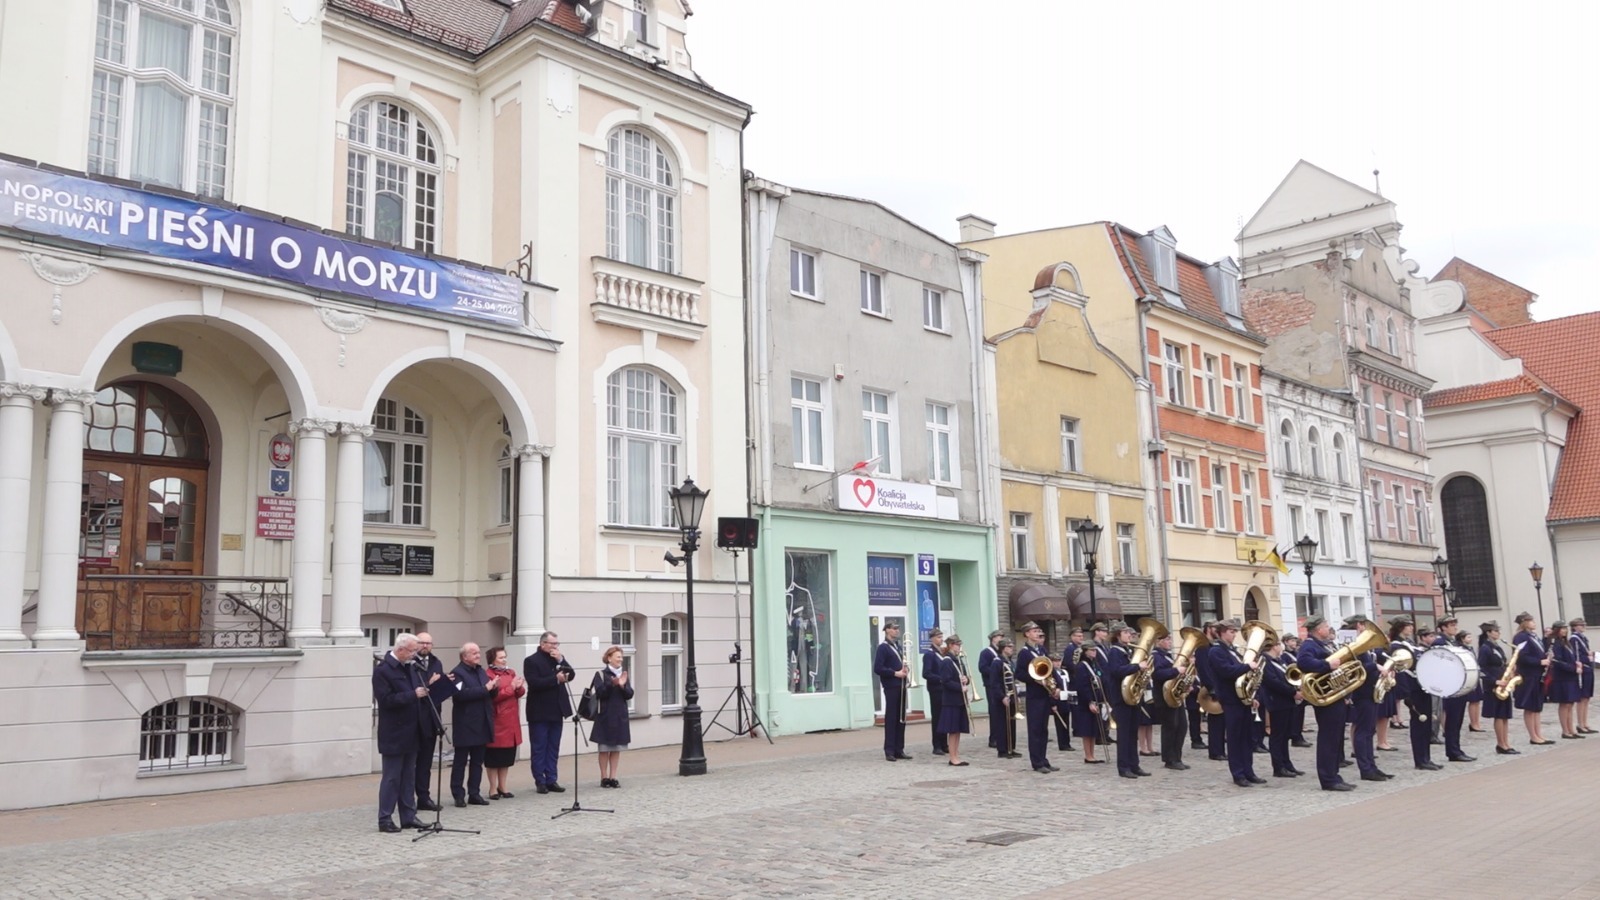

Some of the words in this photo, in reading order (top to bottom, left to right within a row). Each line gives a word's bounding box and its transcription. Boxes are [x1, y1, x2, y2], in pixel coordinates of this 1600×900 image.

[0, 179, 114, 217] NOPOLSKI
[14, 201, 110, 235] FESTIWAL
[120, 201, 254, 261] PIEŚNI
[270, 236, 302, 269] O
[313, 246, 437, 300] MORZU
[457, 295, 518, 316] 24-25.04.2026
[877, 488, 906, 501] Koalicja
[878, 497, 925, 511] Obywatelska
[868, 566, 899, 585] AMANT
[923, 560, 930, 575] 9
